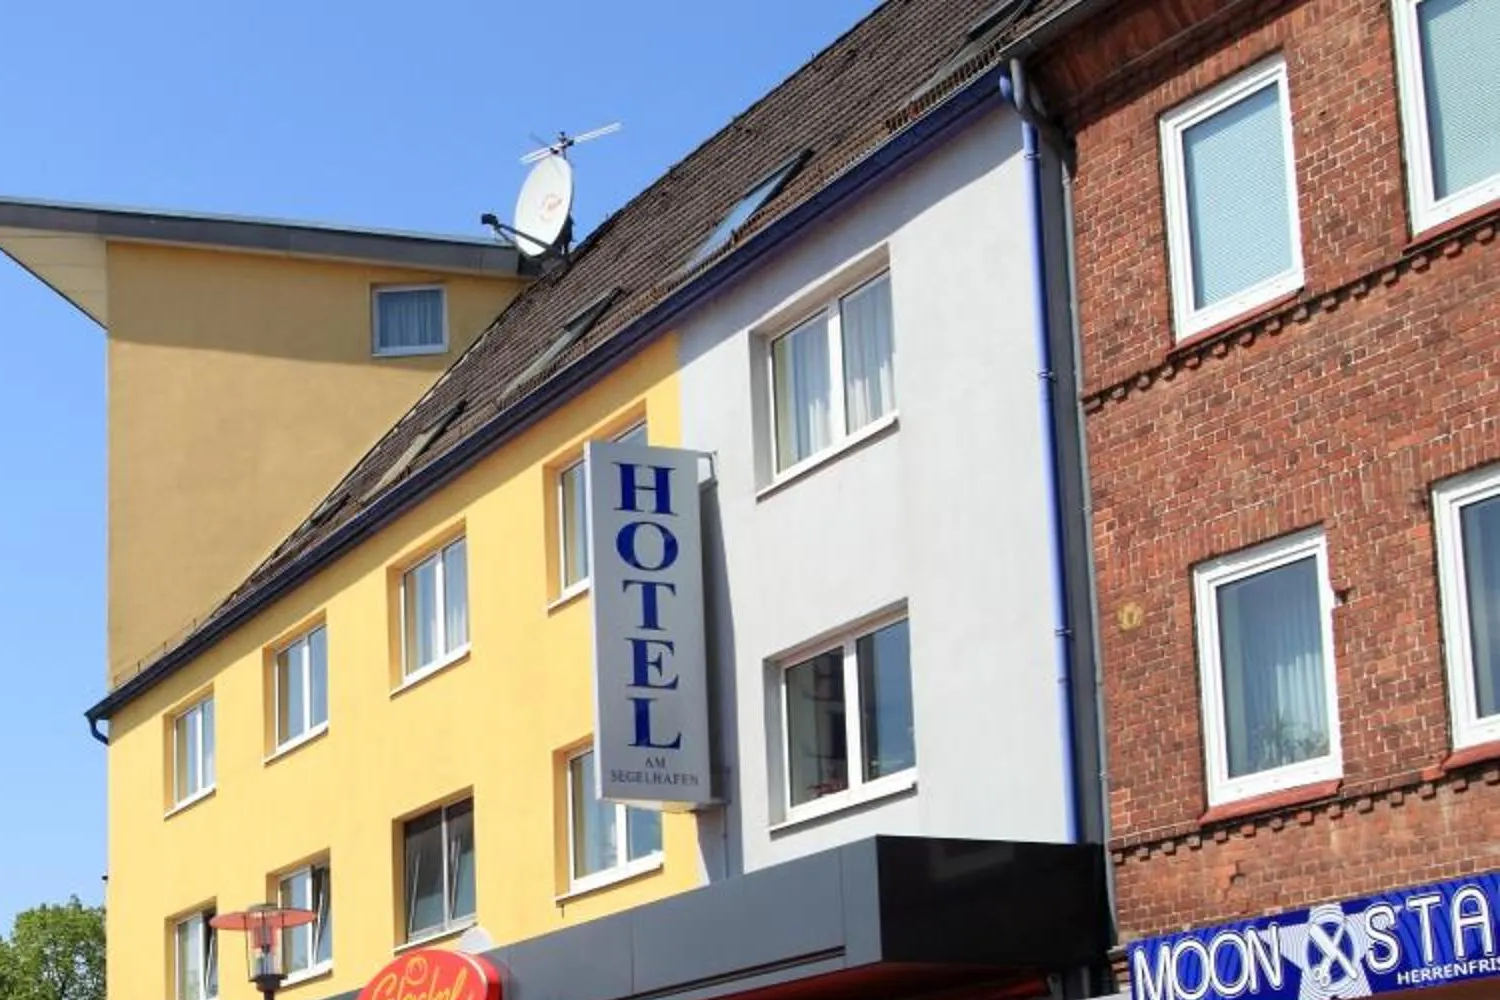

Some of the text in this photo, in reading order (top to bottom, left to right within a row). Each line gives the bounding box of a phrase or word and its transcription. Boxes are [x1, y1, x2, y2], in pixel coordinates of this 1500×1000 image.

[613, 460, 682, 751] HOTEL
[610, 769, 699, 786] SEGELHAFEN
[645, 756, 666, 769] AM
[1363, 883, 1495, 974] STA
